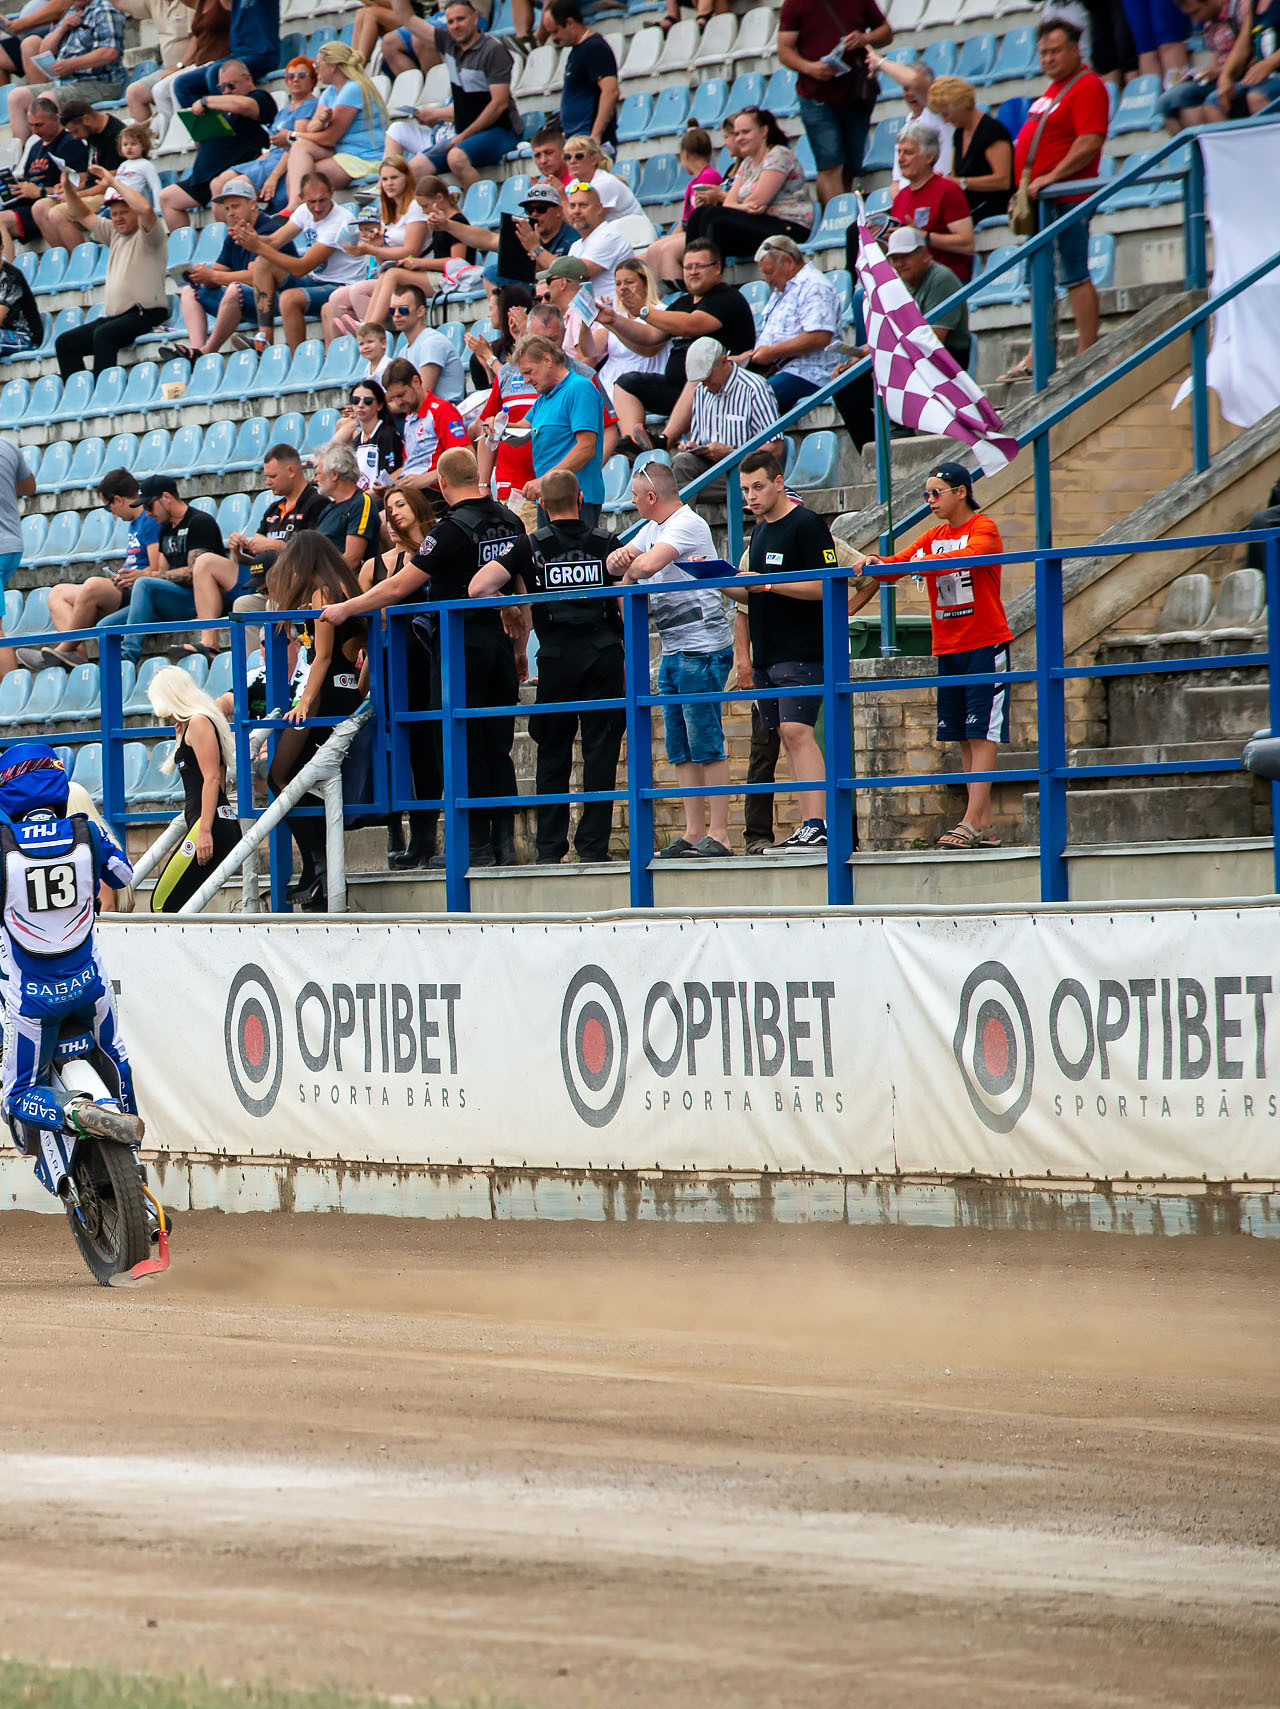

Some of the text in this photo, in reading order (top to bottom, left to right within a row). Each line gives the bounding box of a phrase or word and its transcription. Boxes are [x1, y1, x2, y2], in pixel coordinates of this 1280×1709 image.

[549, 564, 599, 585] GROM
[26, 865, 77, 911] 13
[26, 965, 96, 997] SAGARI
[295, 980, 462, 1075] OPTIBET
[642, 980, 836, 1078] OPTIBET
[1048, 974, 1274, 1082] OPTIBET
[299, 1081, 467, 1109] SPORTA BĀRS
[645, 1085, 844, 1114] SPORTA BĀRS
[1055, 1088, 1278, 1118] SPORTA BĀRS
